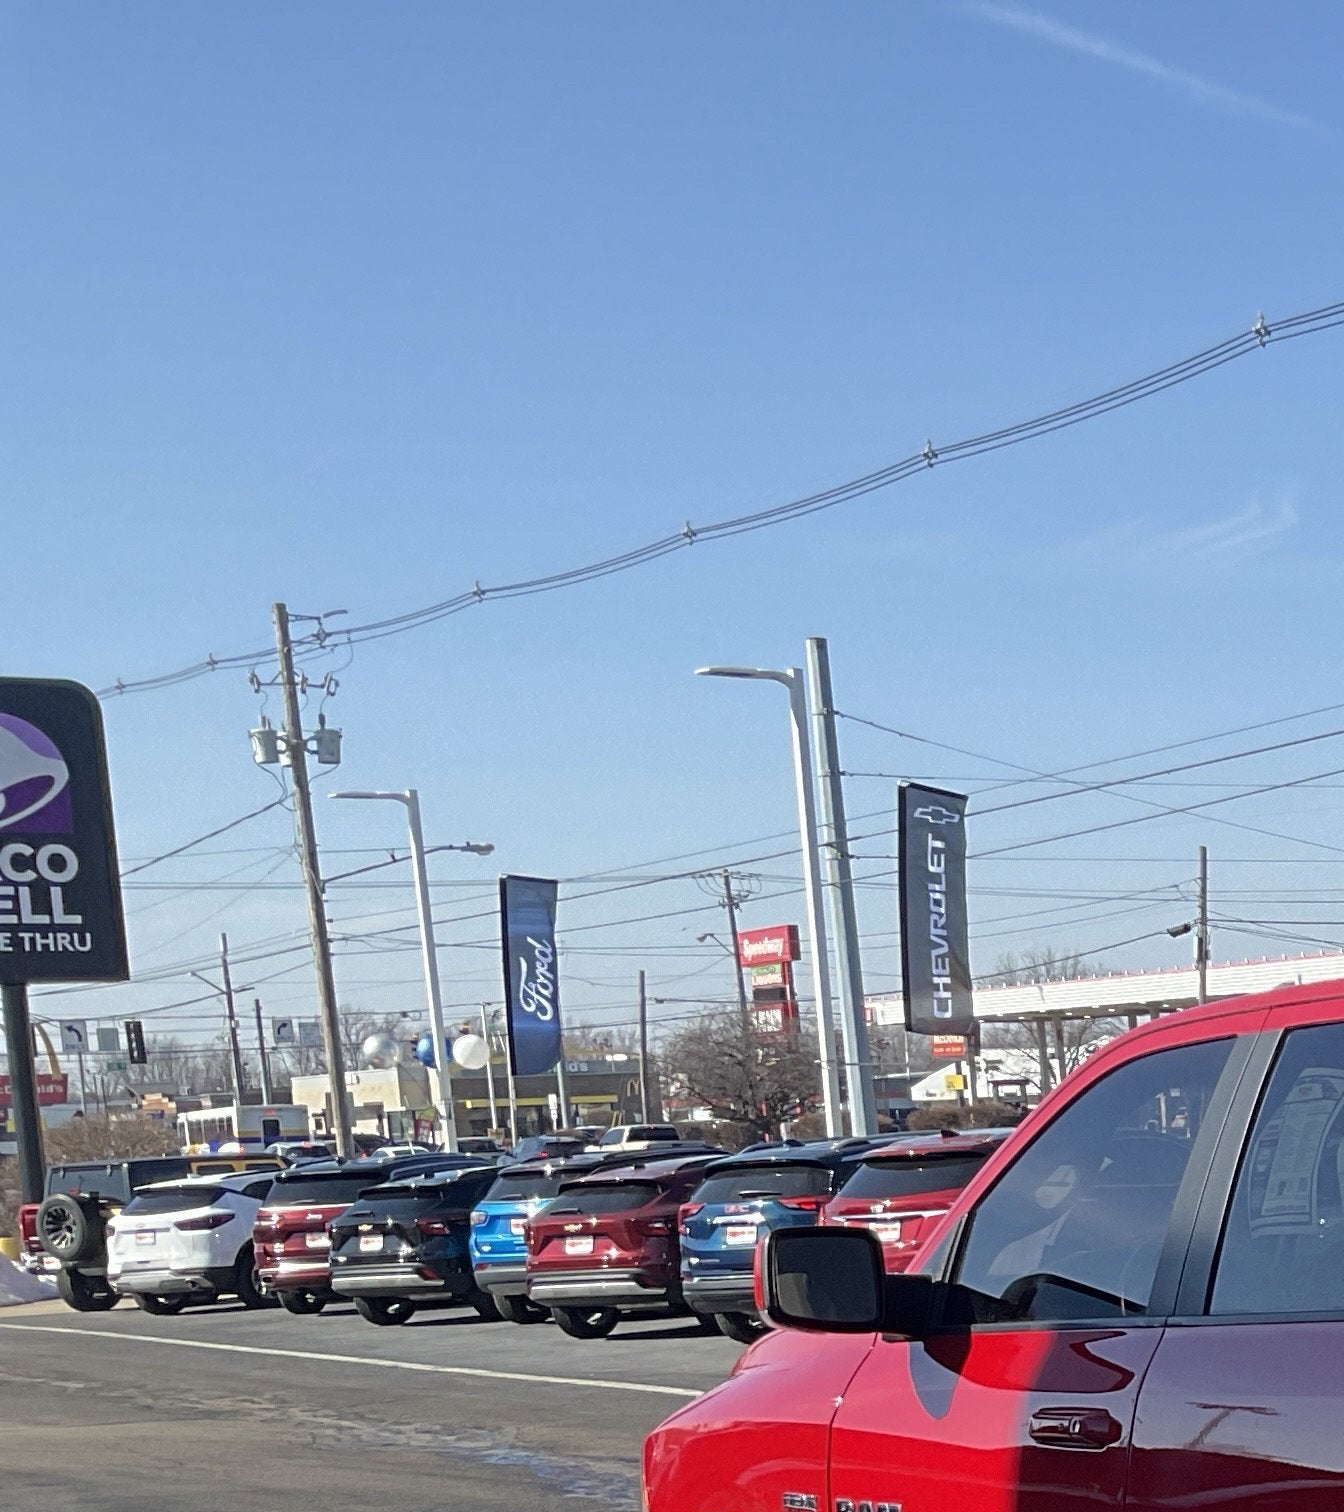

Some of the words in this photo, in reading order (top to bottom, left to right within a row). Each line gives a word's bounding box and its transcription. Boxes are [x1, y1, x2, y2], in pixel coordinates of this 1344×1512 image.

[0, 842, 79, 883] CO
[0, 885, 83, 925] ELL
[927, 832, 952, 1019] CHEVROLET
[18, 932, 92, 952] THRU
[519, 936, 554, 1022] Ford
